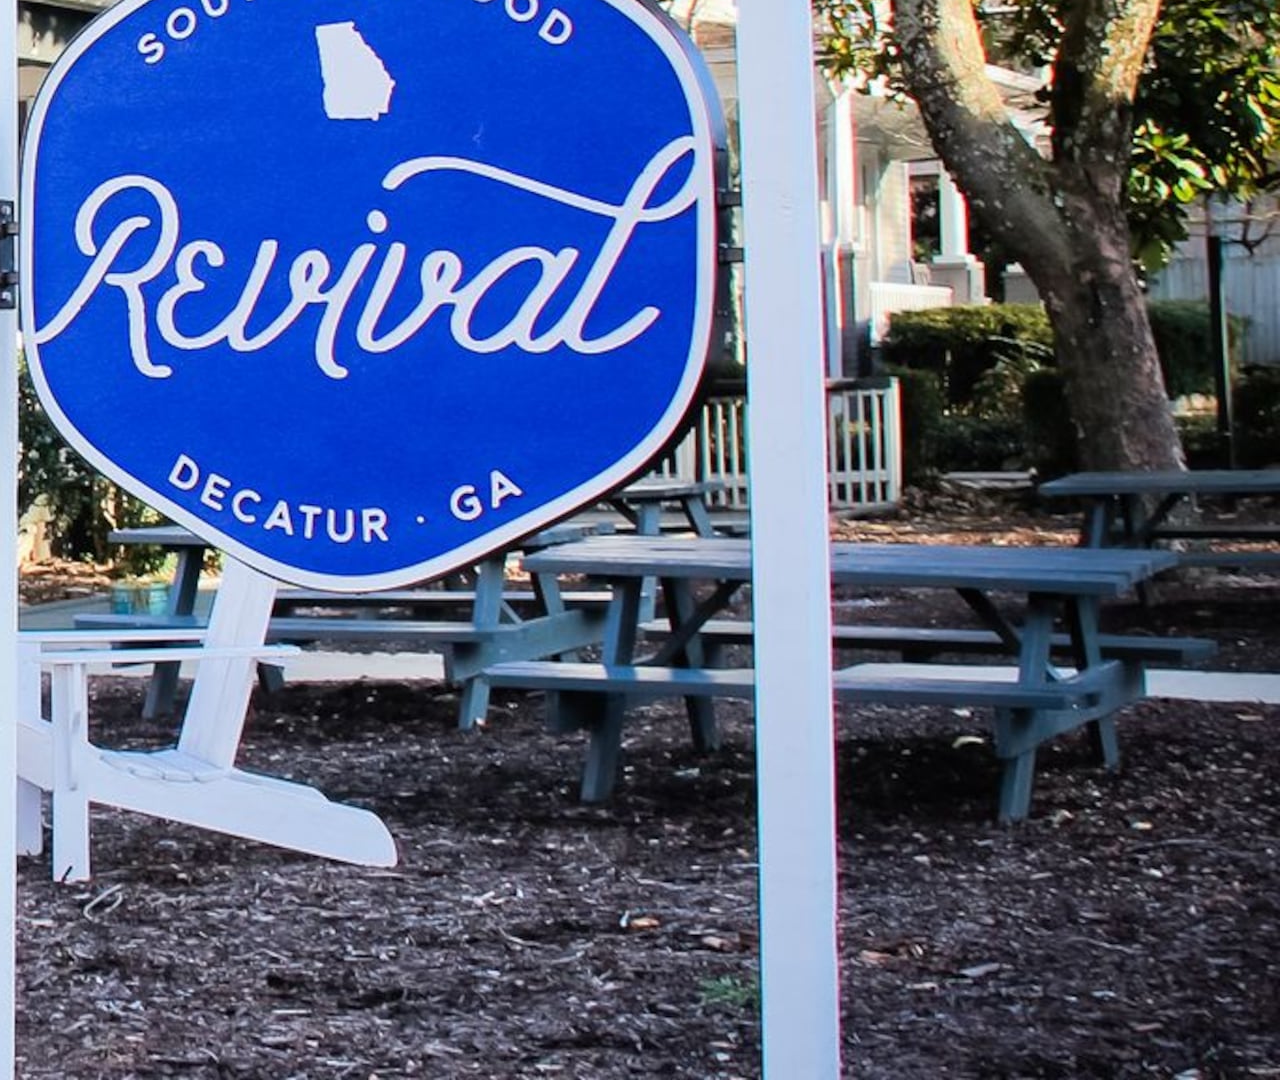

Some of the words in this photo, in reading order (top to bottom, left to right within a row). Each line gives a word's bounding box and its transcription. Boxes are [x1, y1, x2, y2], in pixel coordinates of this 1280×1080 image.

[35, 135, 698, 379] Revival
[168, 454, 389, 543] DECATUR
[450, 470, 523, 521] GA
